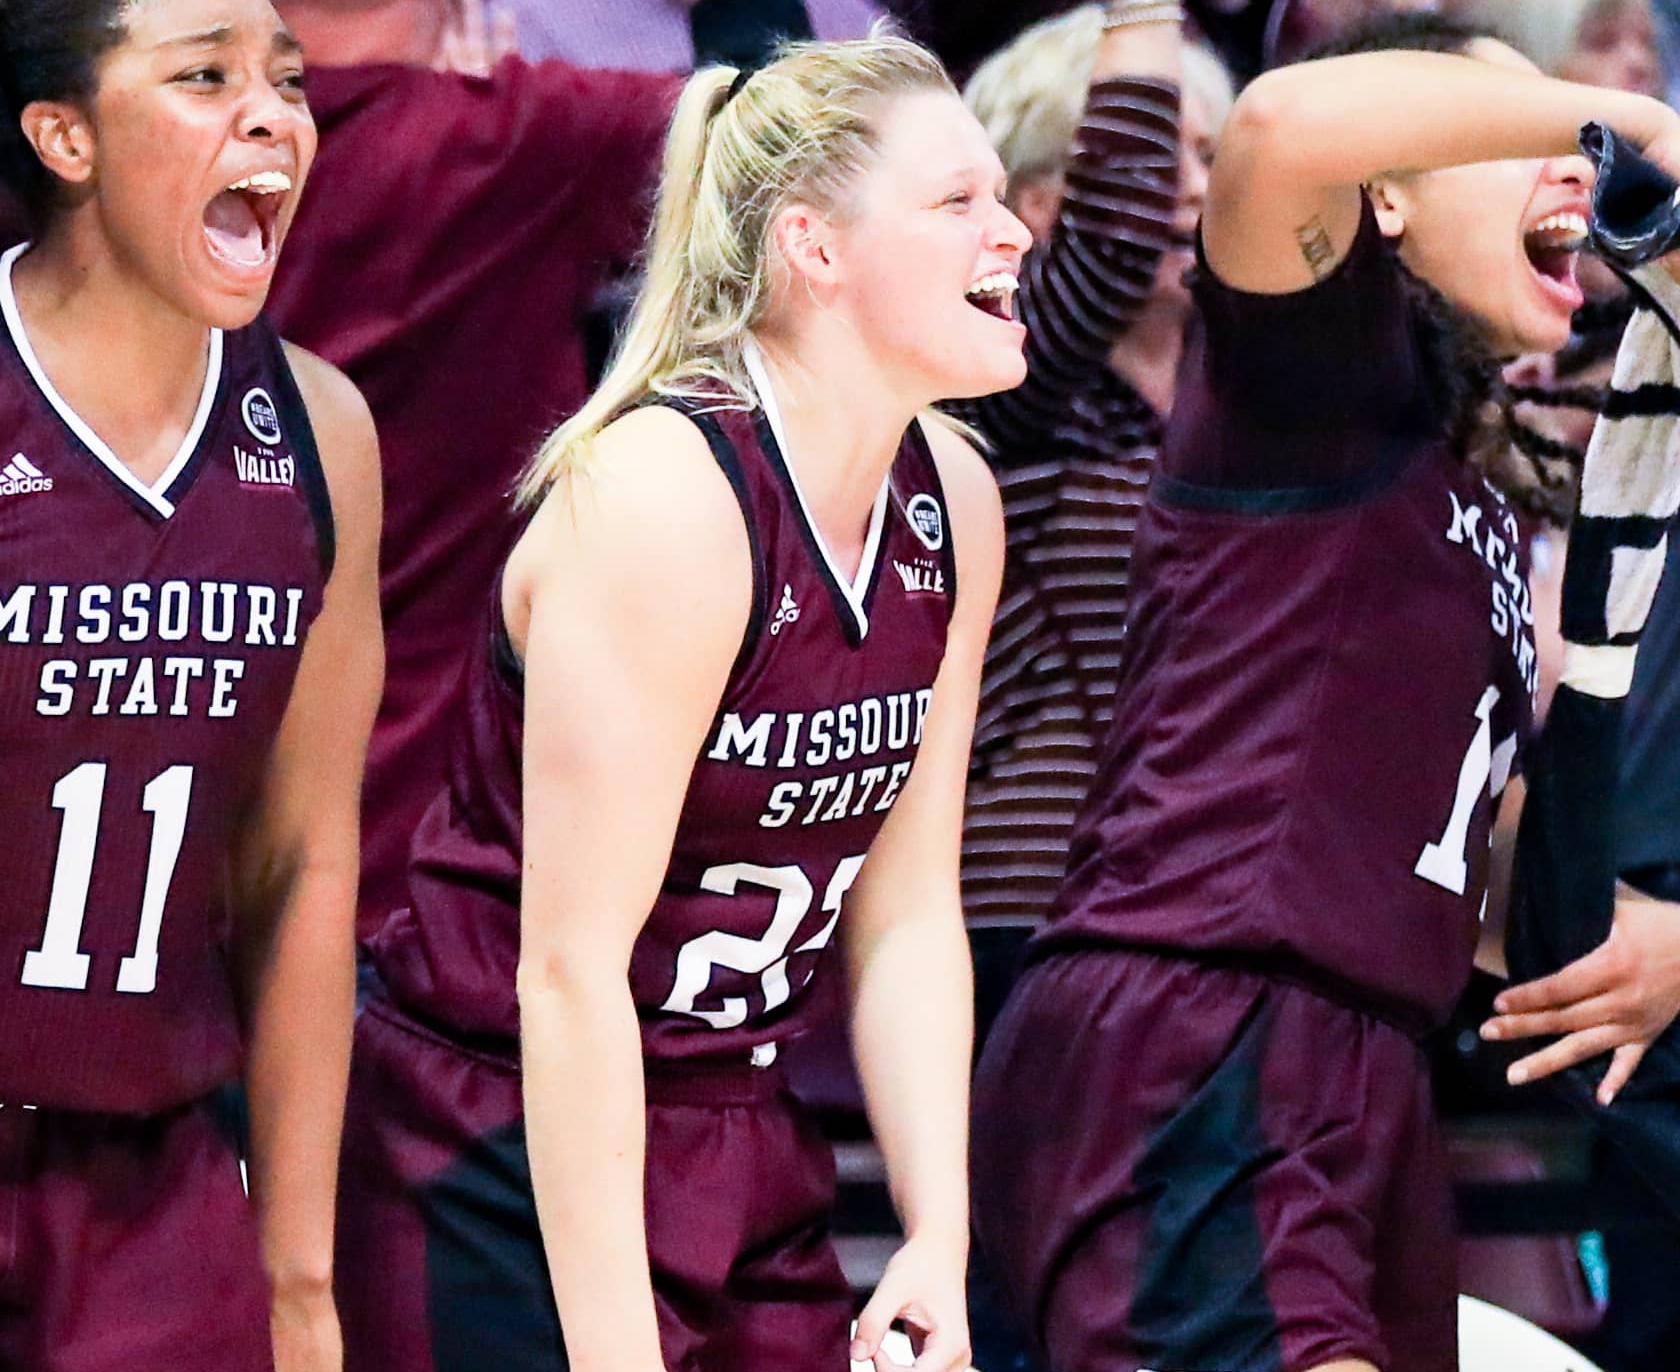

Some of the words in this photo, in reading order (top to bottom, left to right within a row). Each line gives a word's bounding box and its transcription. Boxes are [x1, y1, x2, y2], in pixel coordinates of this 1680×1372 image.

[233, 445, 295, 486] VALLEY
[36, 657, 244, 717] STATE
[759, 761, 911, 827] STATE
[20, 762, 194, 994] 11
